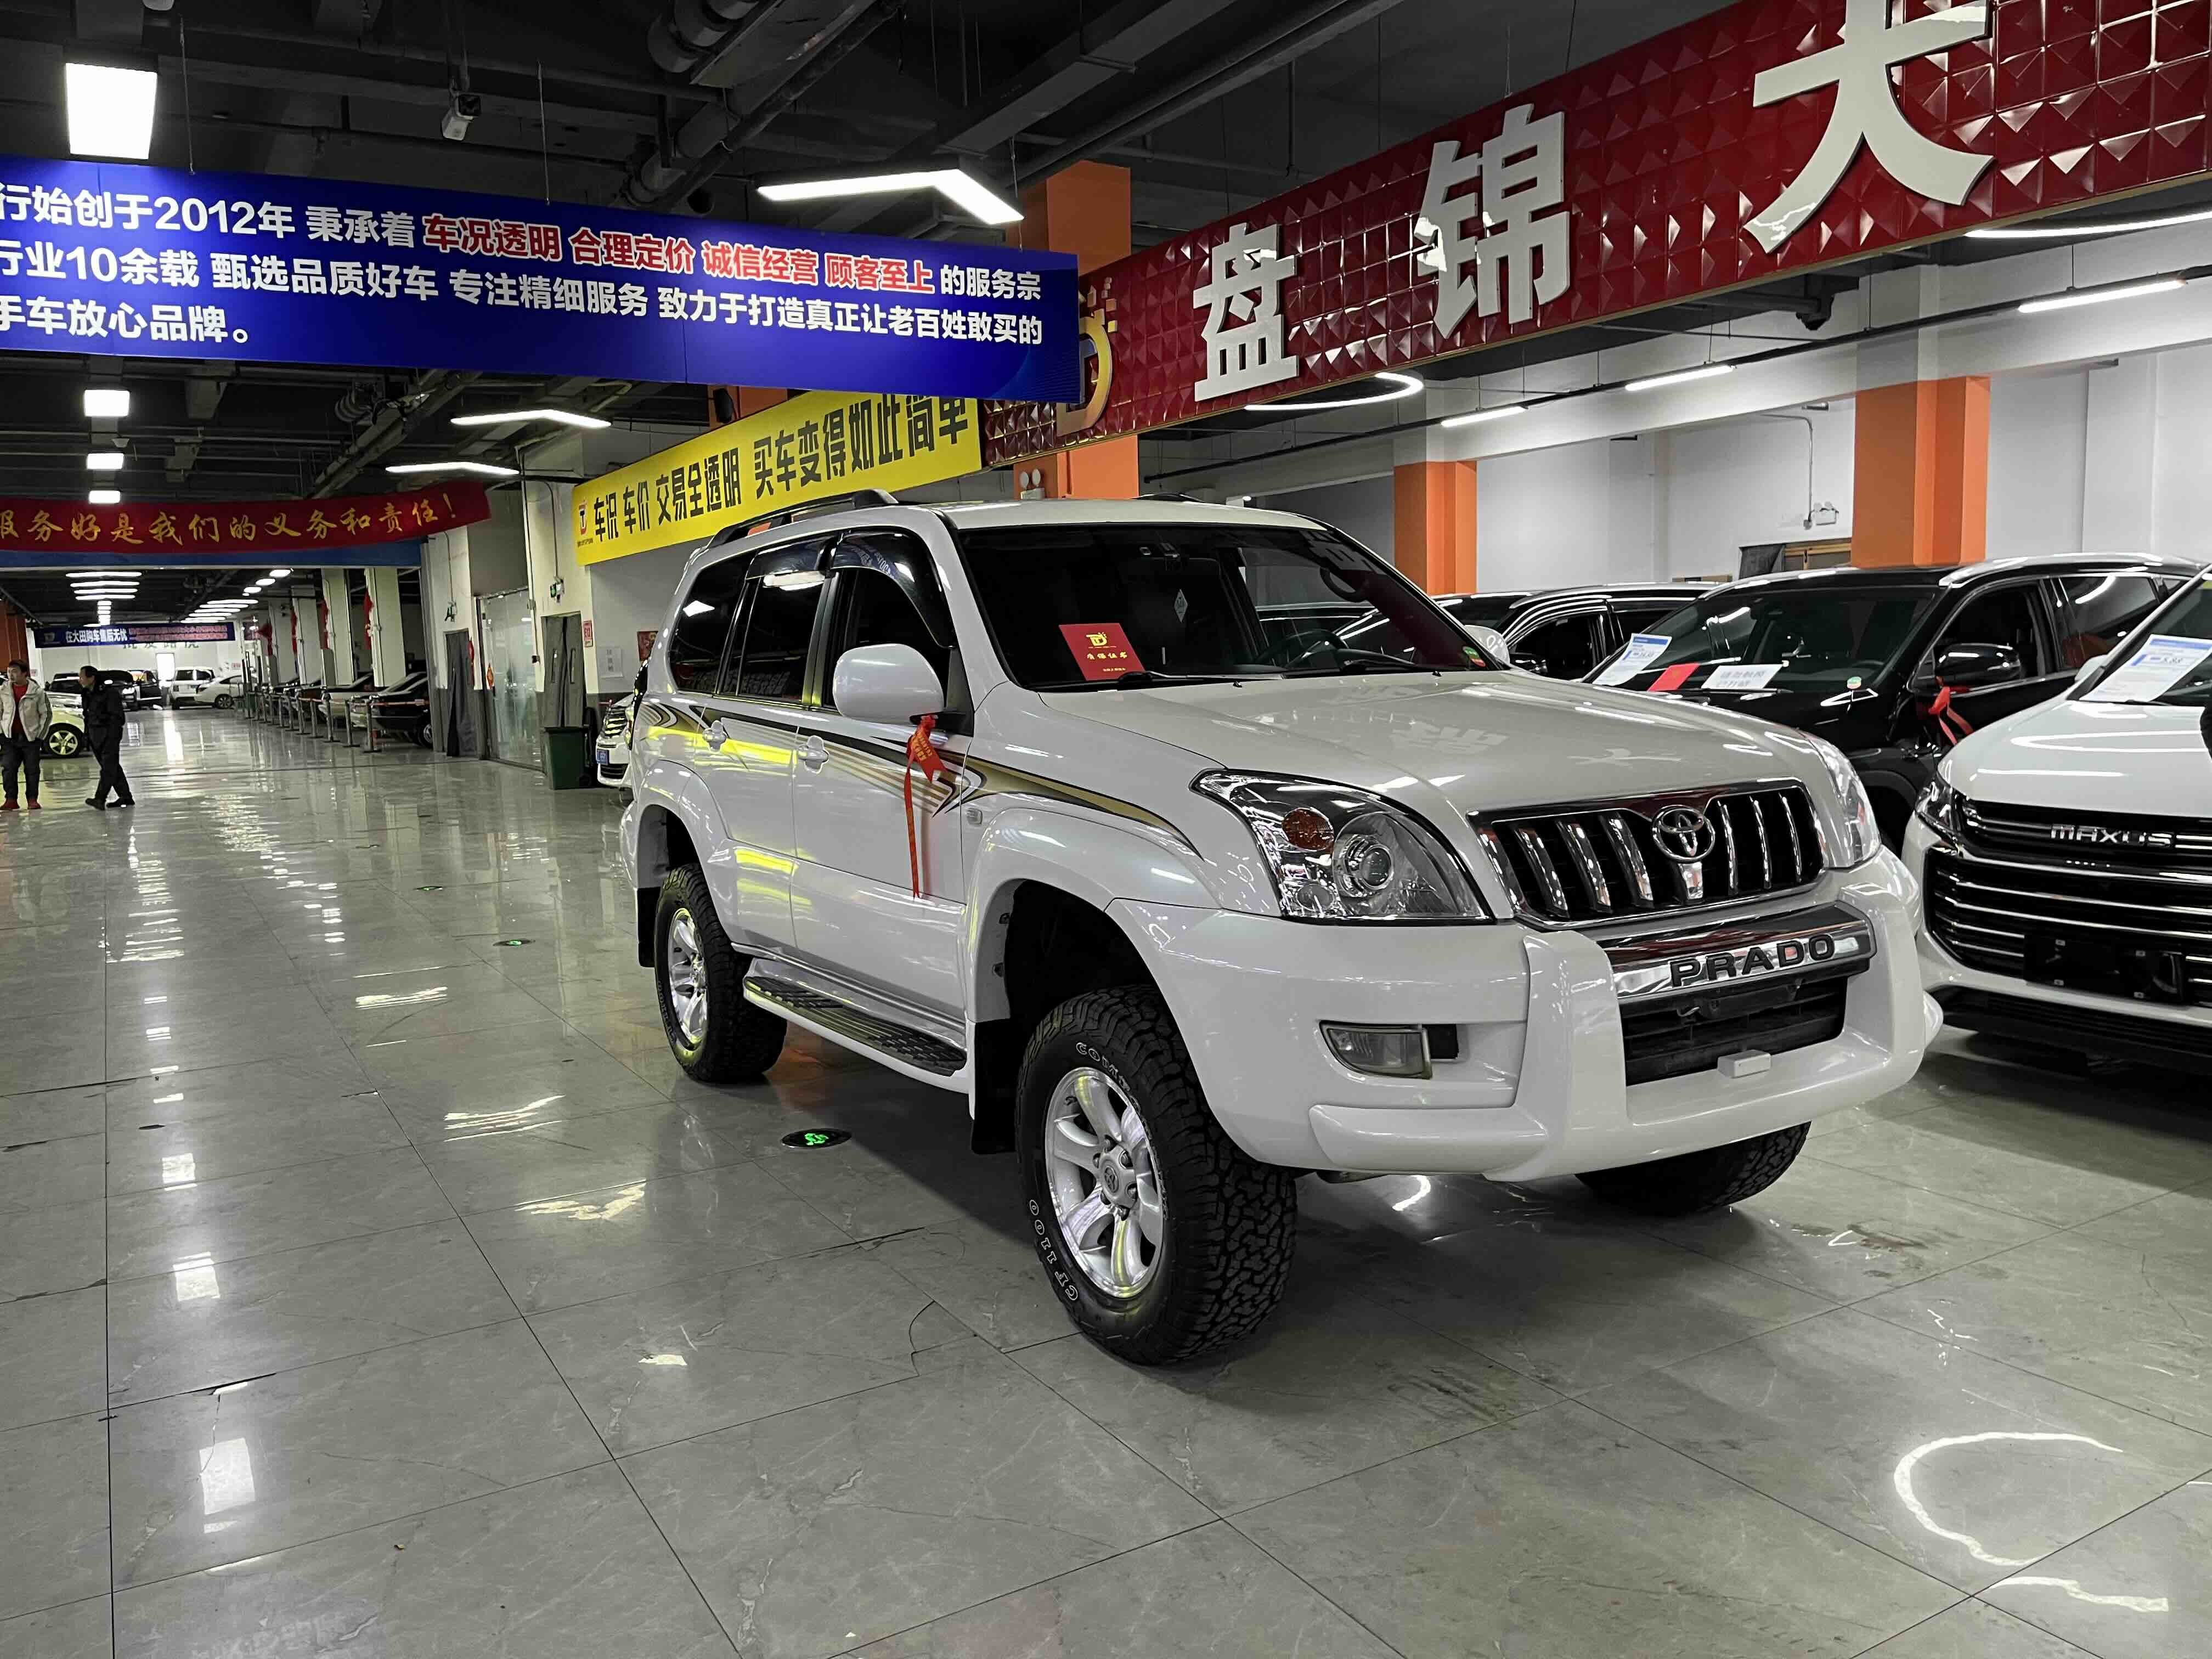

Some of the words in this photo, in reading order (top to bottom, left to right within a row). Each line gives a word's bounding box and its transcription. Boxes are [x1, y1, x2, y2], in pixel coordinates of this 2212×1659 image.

[0, 182, 295, 239] 行始创于2012年
[307, 205, 415, 249] 秉承着
[423, 213, 562, 262] 车况透明
[569, 228, 696, 274] 合理定价
[702, 241, 819, 286] 诚信经营
[825, 253, 934, 294] 顾客至上
[940, 264, 1041, 301] 的服务宗
[210, 253, 439, 302] 甄选品质好车
[449, 269, 648, 318] 专注精细服务
[657, 286, 1042, 346] 致力于打造真正让老百姓敢买的
[594, 492, 619, 542] 车况
[623, 478, 651, 534] 车价
[656, 447, 742, 527] 交易全透明
[753, 394, 968, 499] 买车变得如此简单
[1669, 934, 1835, 988] PRADO
